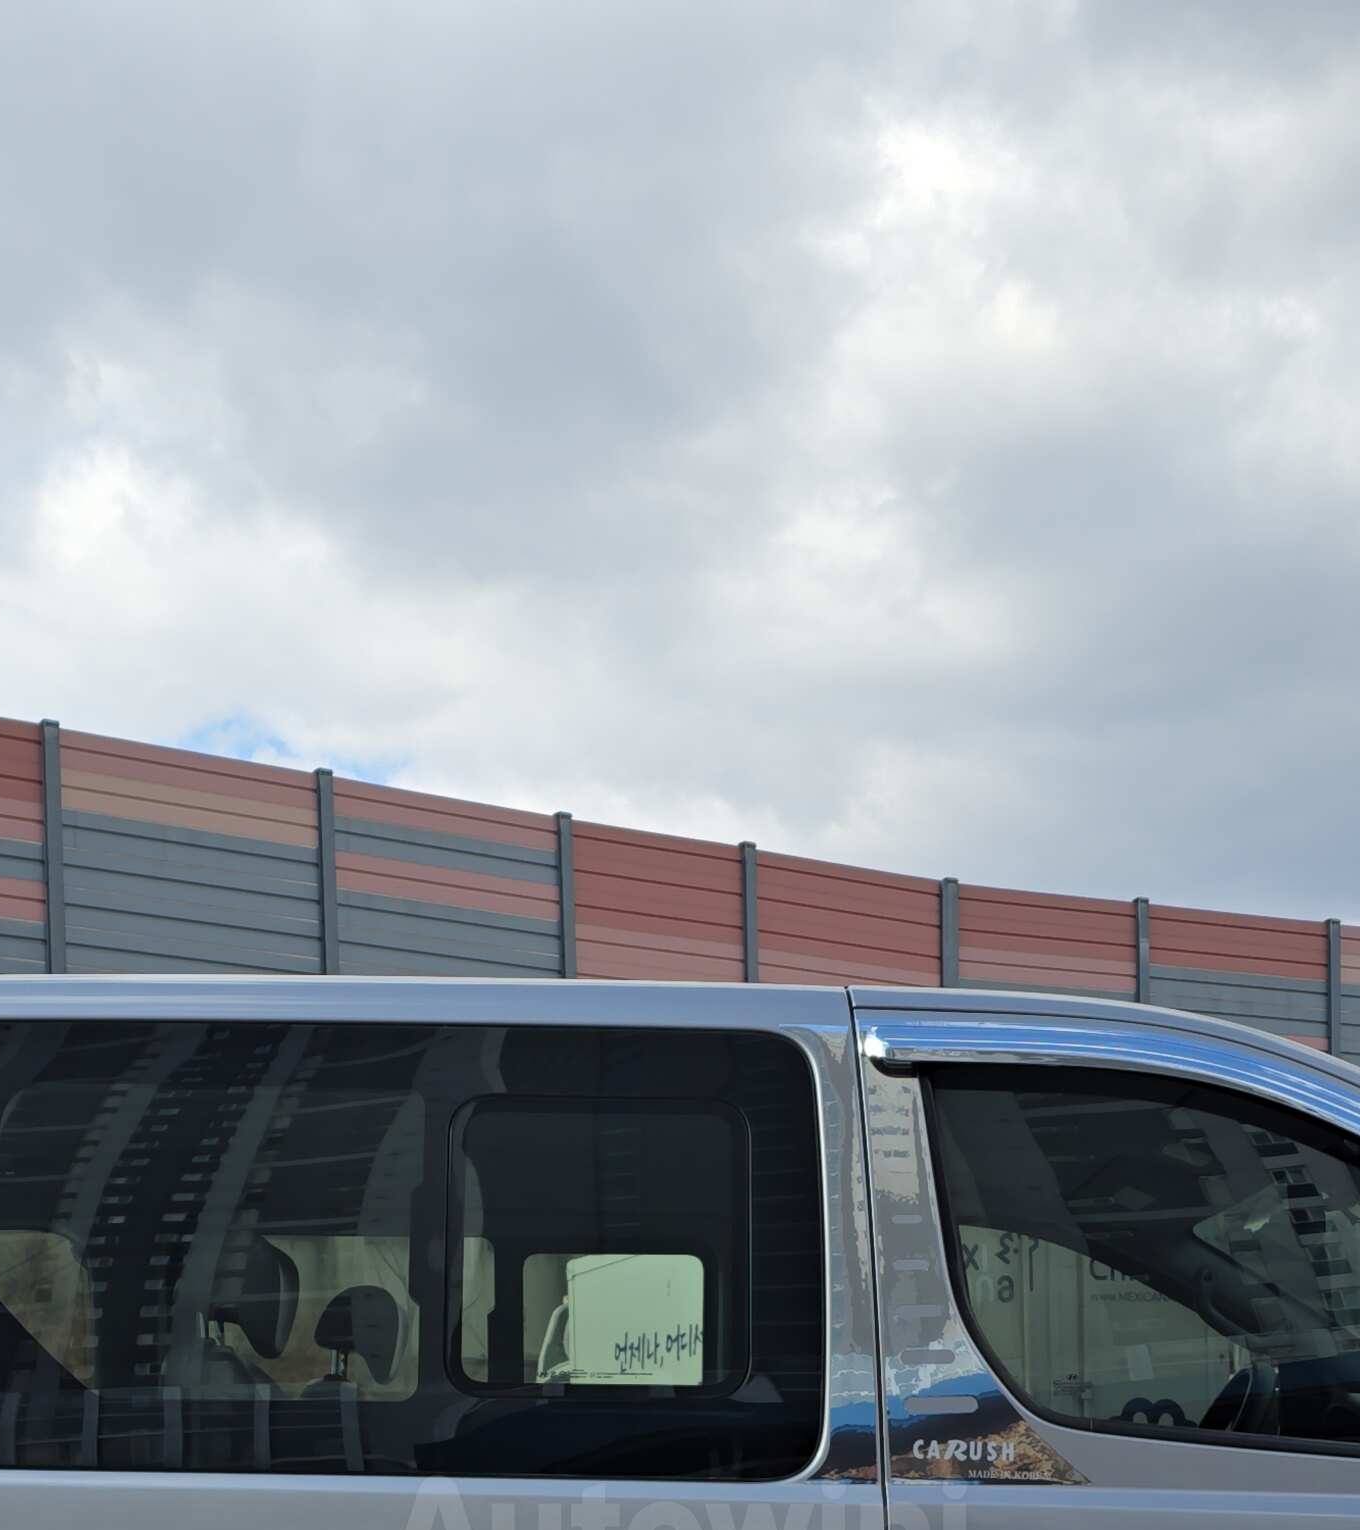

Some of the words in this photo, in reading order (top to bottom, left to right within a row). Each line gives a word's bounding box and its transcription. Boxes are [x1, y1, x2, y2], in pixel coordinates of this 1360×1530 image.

[614, 1331, 665, 1373] 언제나,
[912, 1438, 1016, 1462] CARUSH
[968, 1469, 996, 1479] MADE
